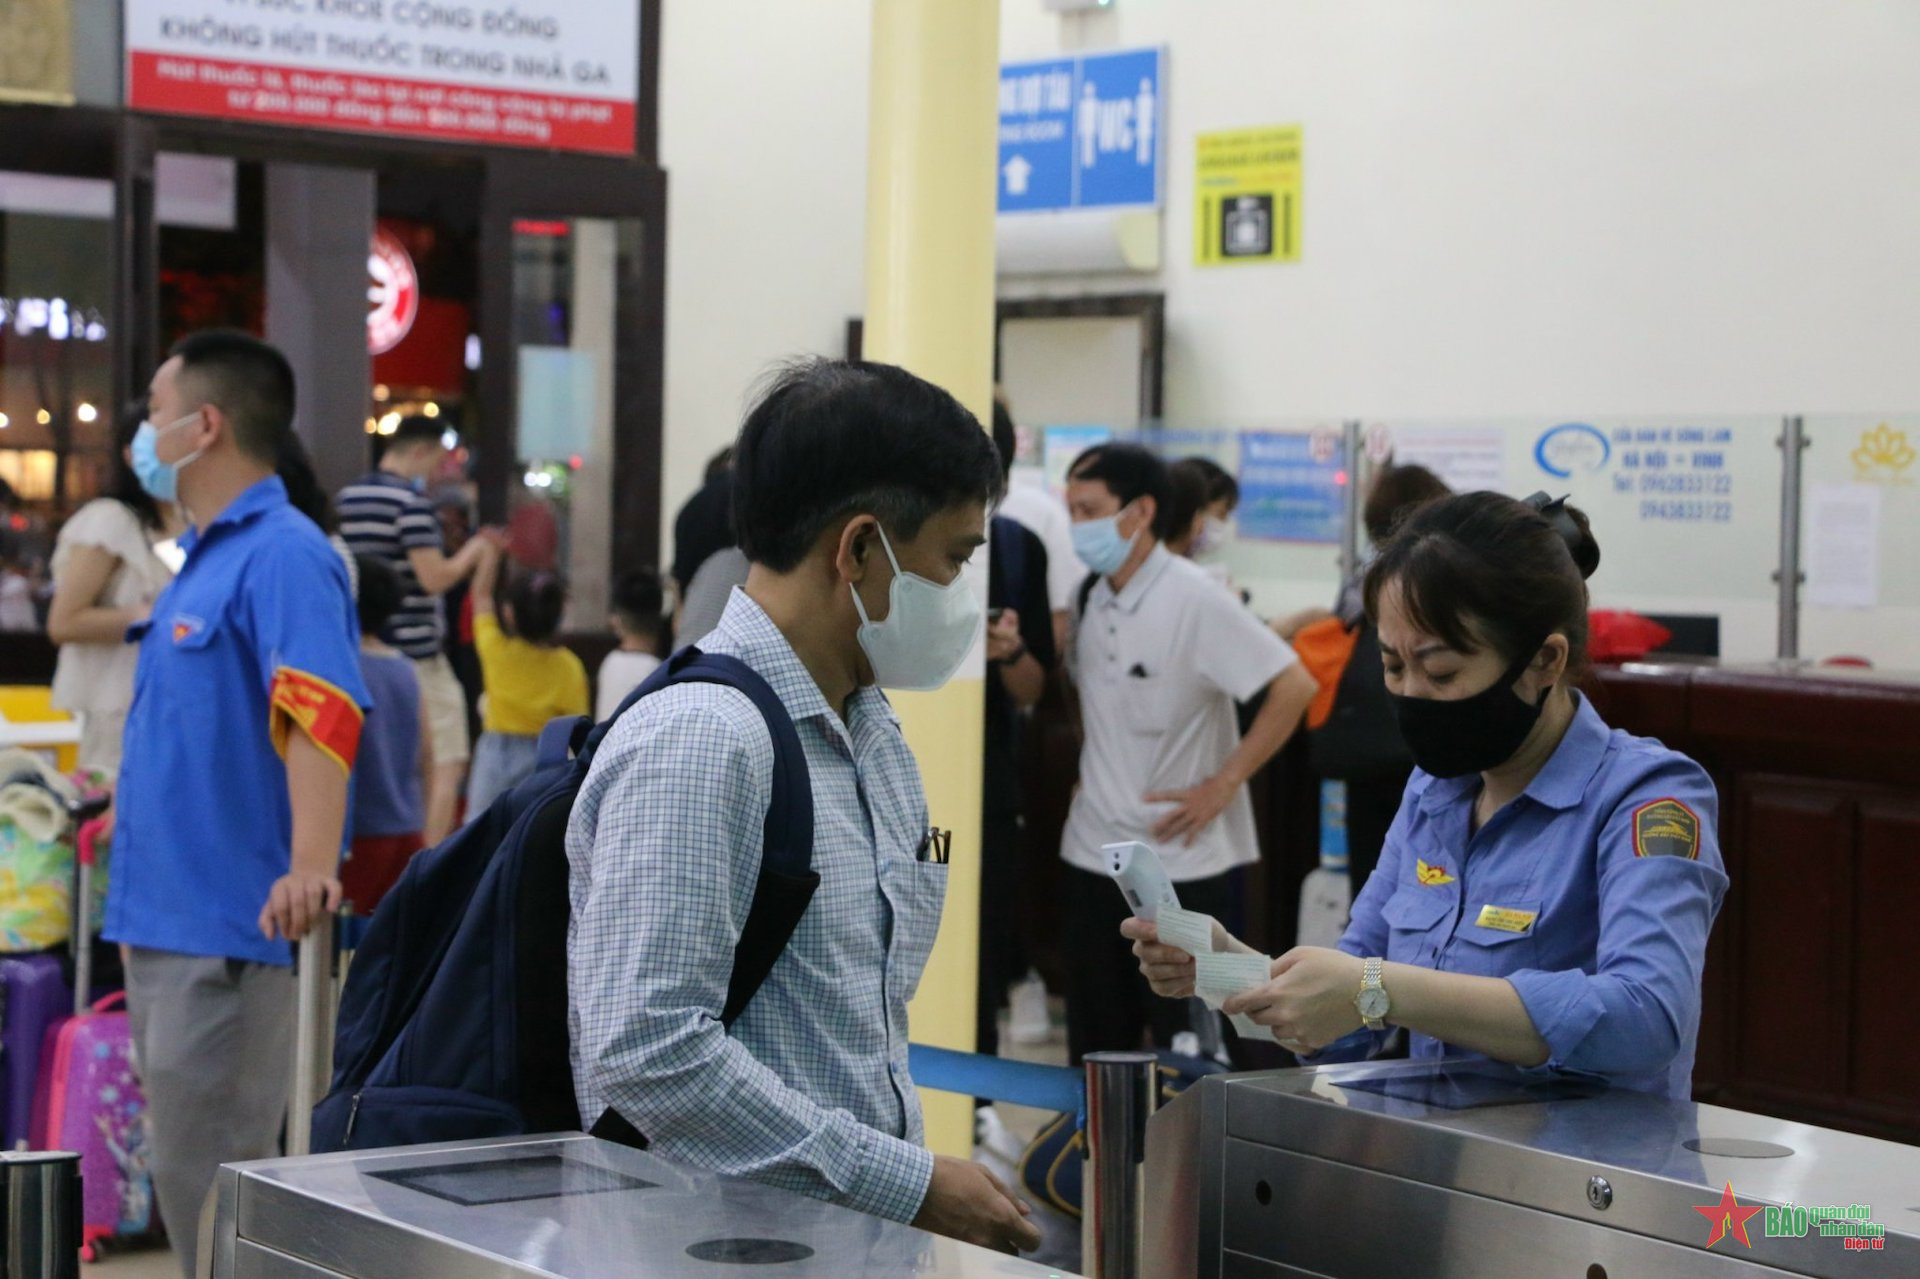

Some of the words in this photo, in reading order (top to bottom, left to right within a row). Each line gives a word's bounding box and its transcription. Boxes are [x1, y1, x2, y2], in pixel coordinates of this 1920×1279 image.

[482, 8, 559, 39] ĐỒNG
[160, 14, 262, 47] KHÔNG
[270, 23, 317, 52] HÚT
[326, 32, 412, 67] THUỐC
[421, 42, 505, 74] TRONG
[512, 50, 566, 80] NHÀ
[572, 60, 612, 84] GA
